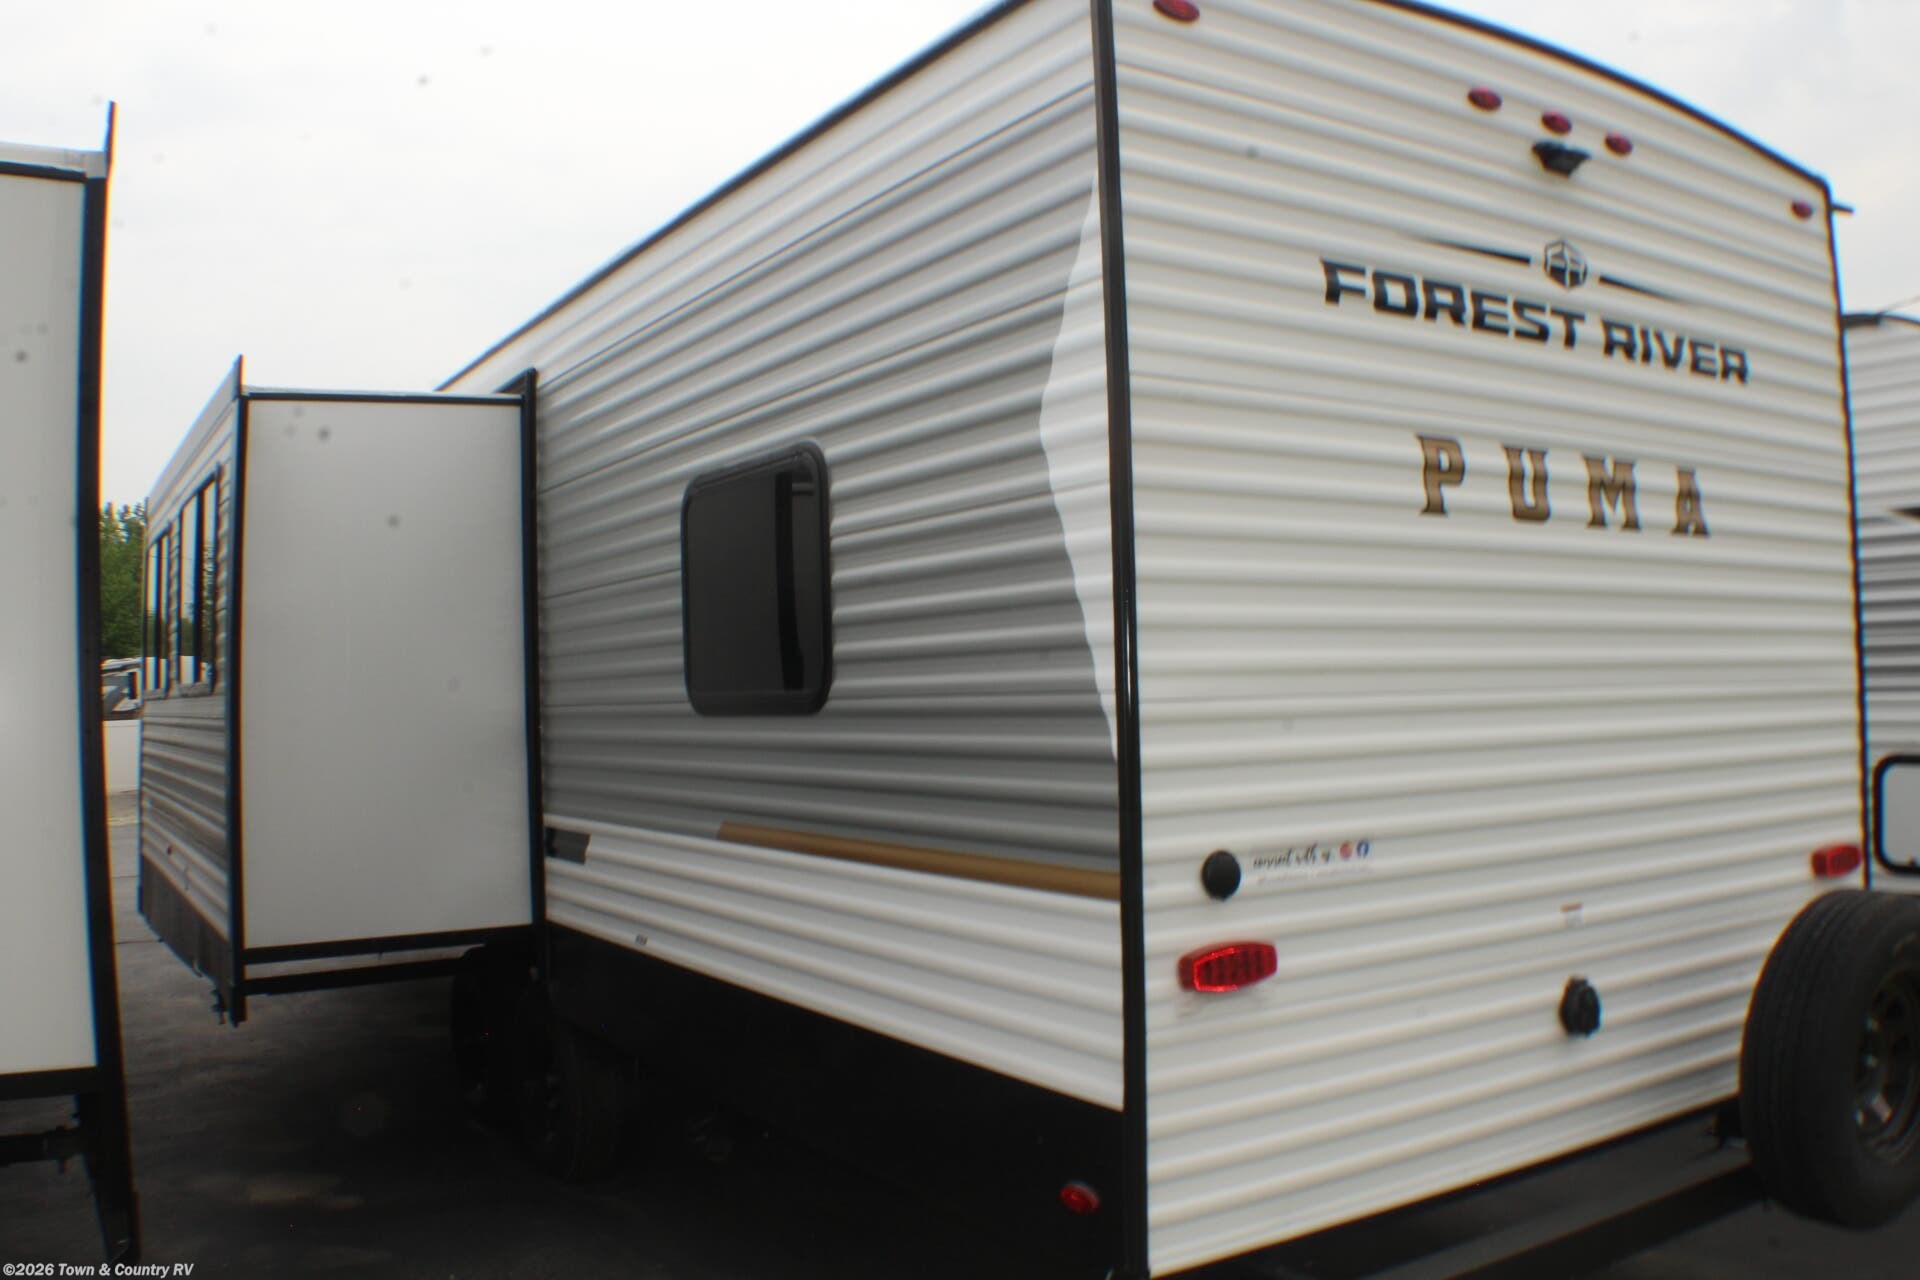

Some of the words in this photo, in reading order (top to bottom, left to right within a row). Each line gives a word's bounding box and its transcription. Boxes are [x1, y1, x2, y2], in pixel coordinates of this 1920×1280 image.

[1320, 258, 1586, 349] FOREST
[1602, 318, 1750, 384] RIVER
[1416, 433, 1711, 538] PUMA
